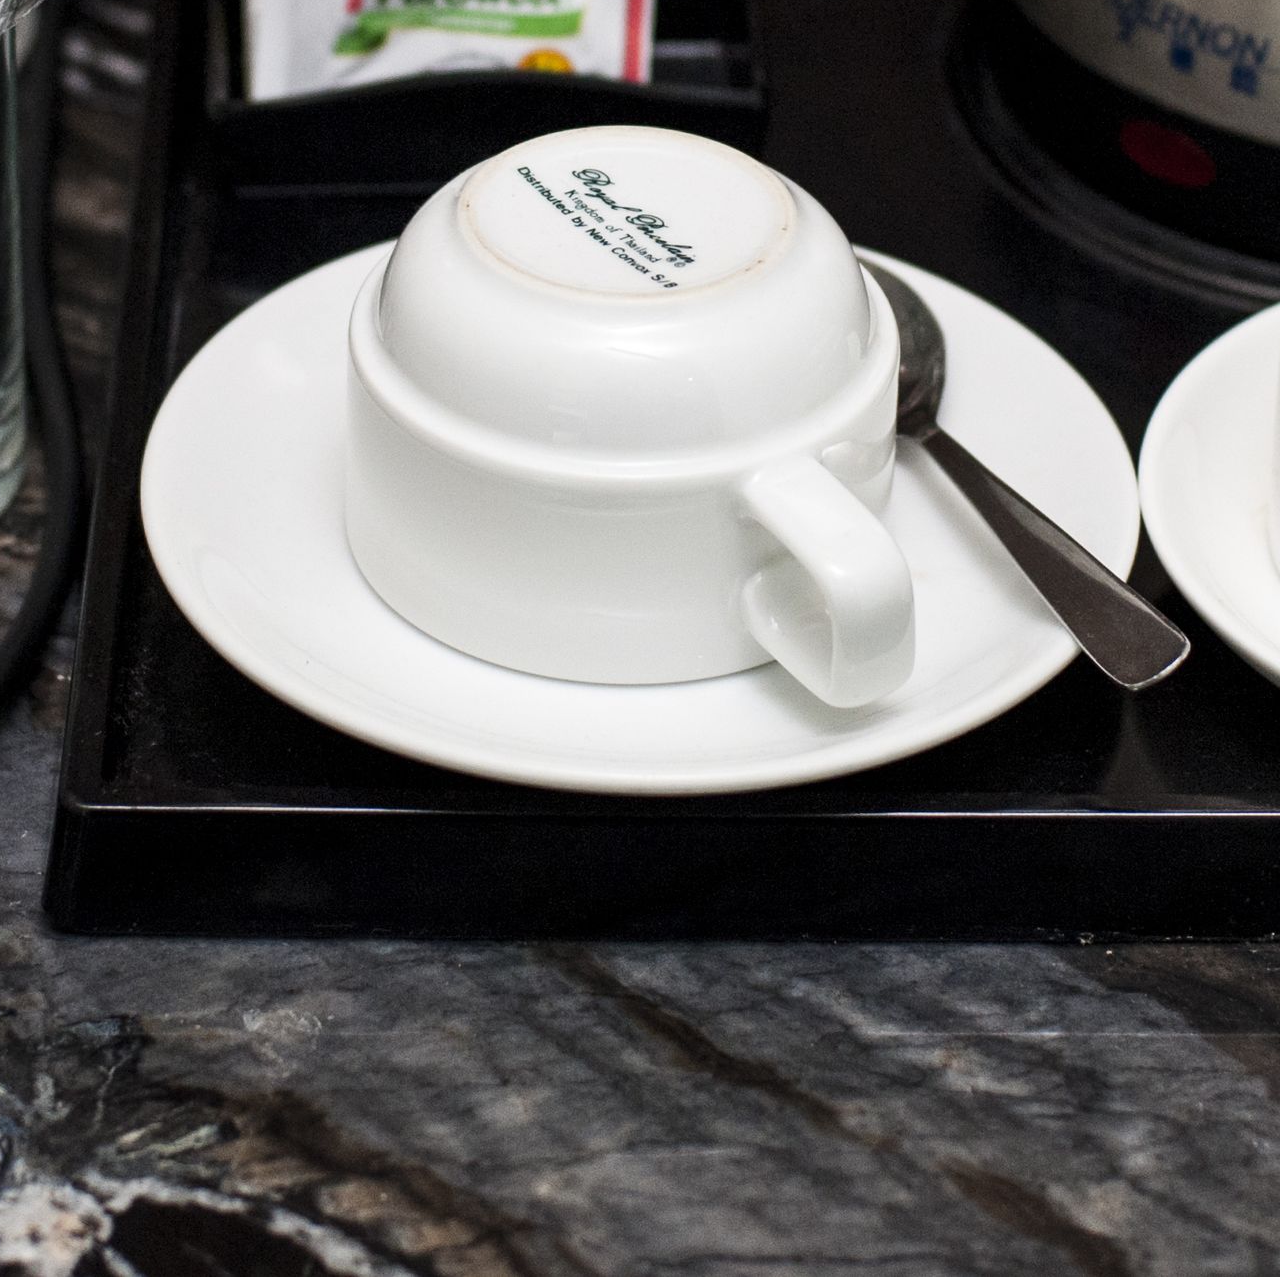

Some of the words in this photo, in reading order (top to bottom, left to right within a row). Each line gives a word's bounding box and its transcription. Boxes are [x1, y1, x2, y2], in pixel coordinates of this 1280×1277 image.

[517, 166, 574, 216] Distributed
[571, 216, 588, 228] by
[586, 228, 611, 246] New
[564, 189, 605, 223] Kingdom
[605, 225, 623, 234] of
[619, 233, 662, 263] Thailand
[572, 168, 642, 211] Royal
